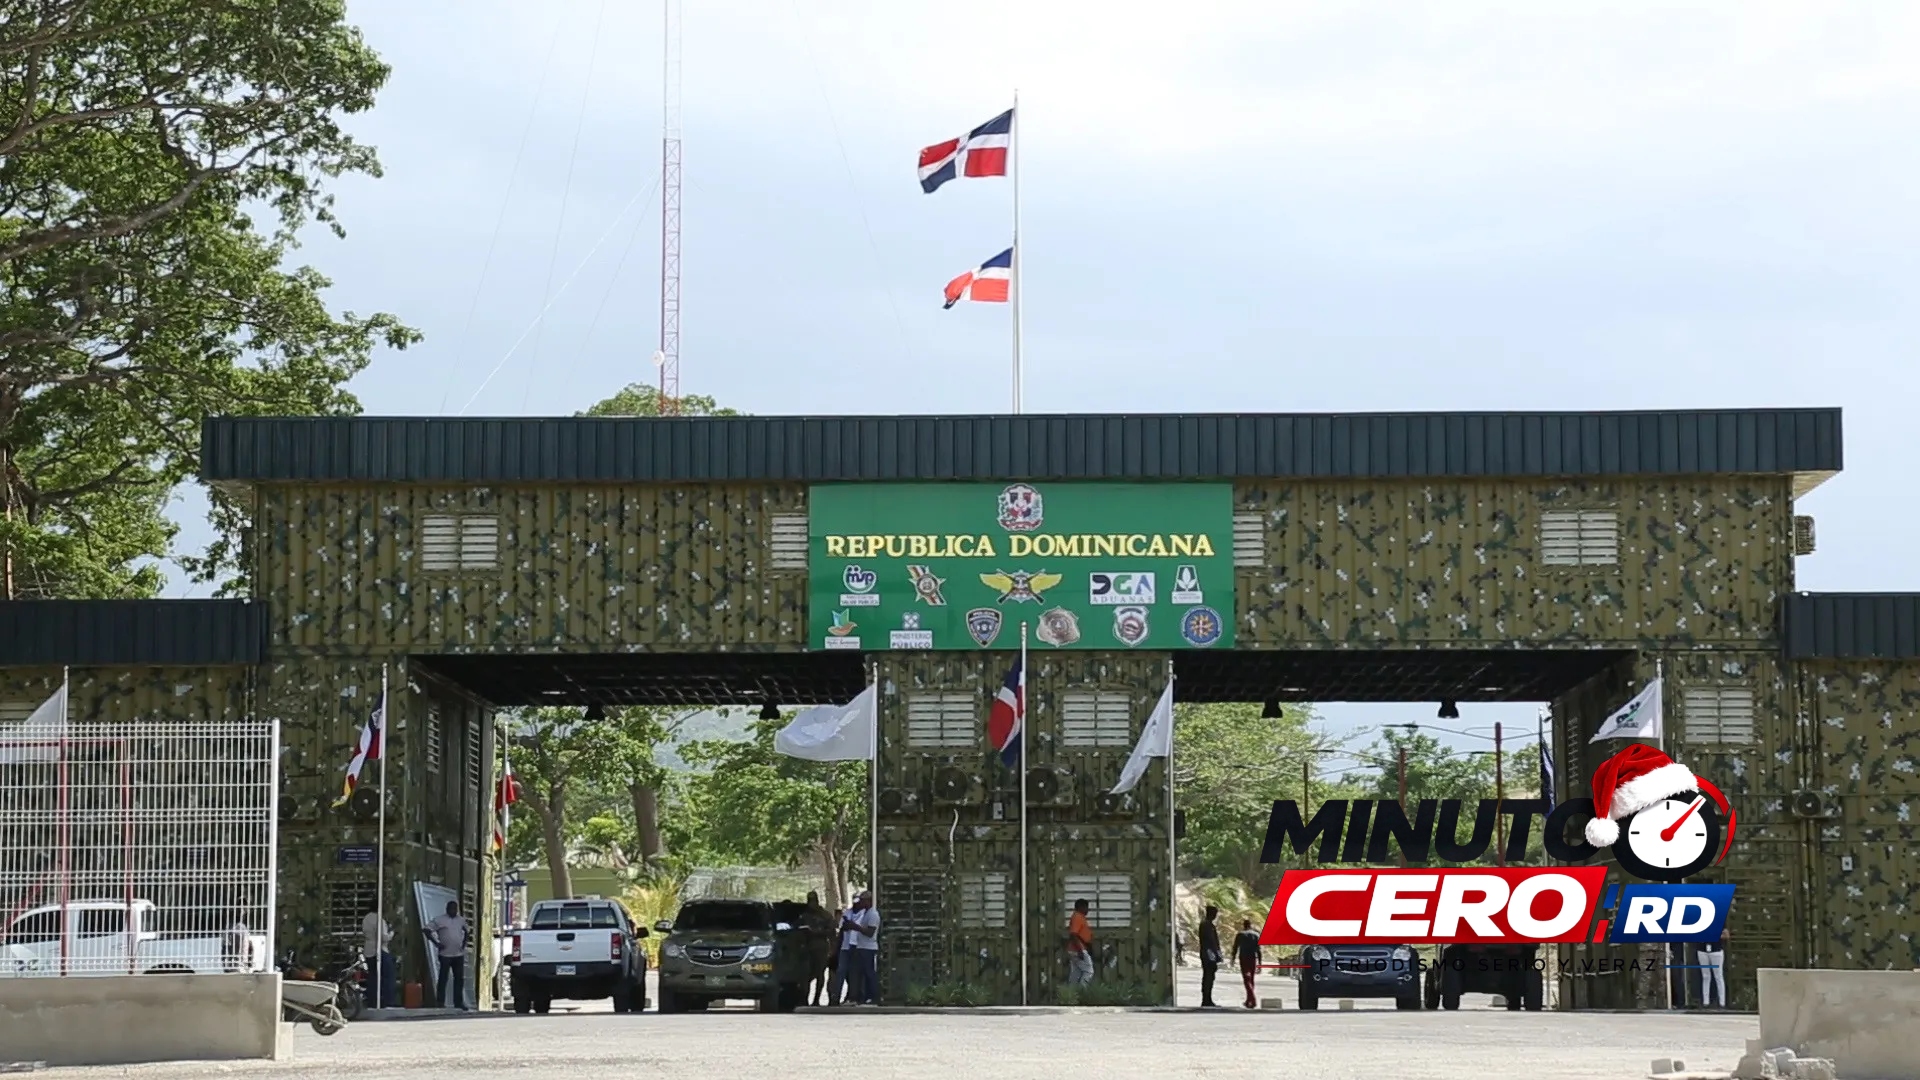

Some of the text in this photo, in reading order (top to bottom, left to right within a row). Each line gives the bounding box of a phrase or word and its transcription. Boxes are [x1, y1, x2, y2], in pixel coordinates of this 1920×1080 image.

[825, 534, 1215, 558] REPUBLICA DOMINICANA
[1092, 575, 1152, 595] DGA
[1092, 595, 1154, 604] ADUANAS
[891, 632, 931, 640] MINISTERIO
[892, 640, 931, 649] PÚBLICO
